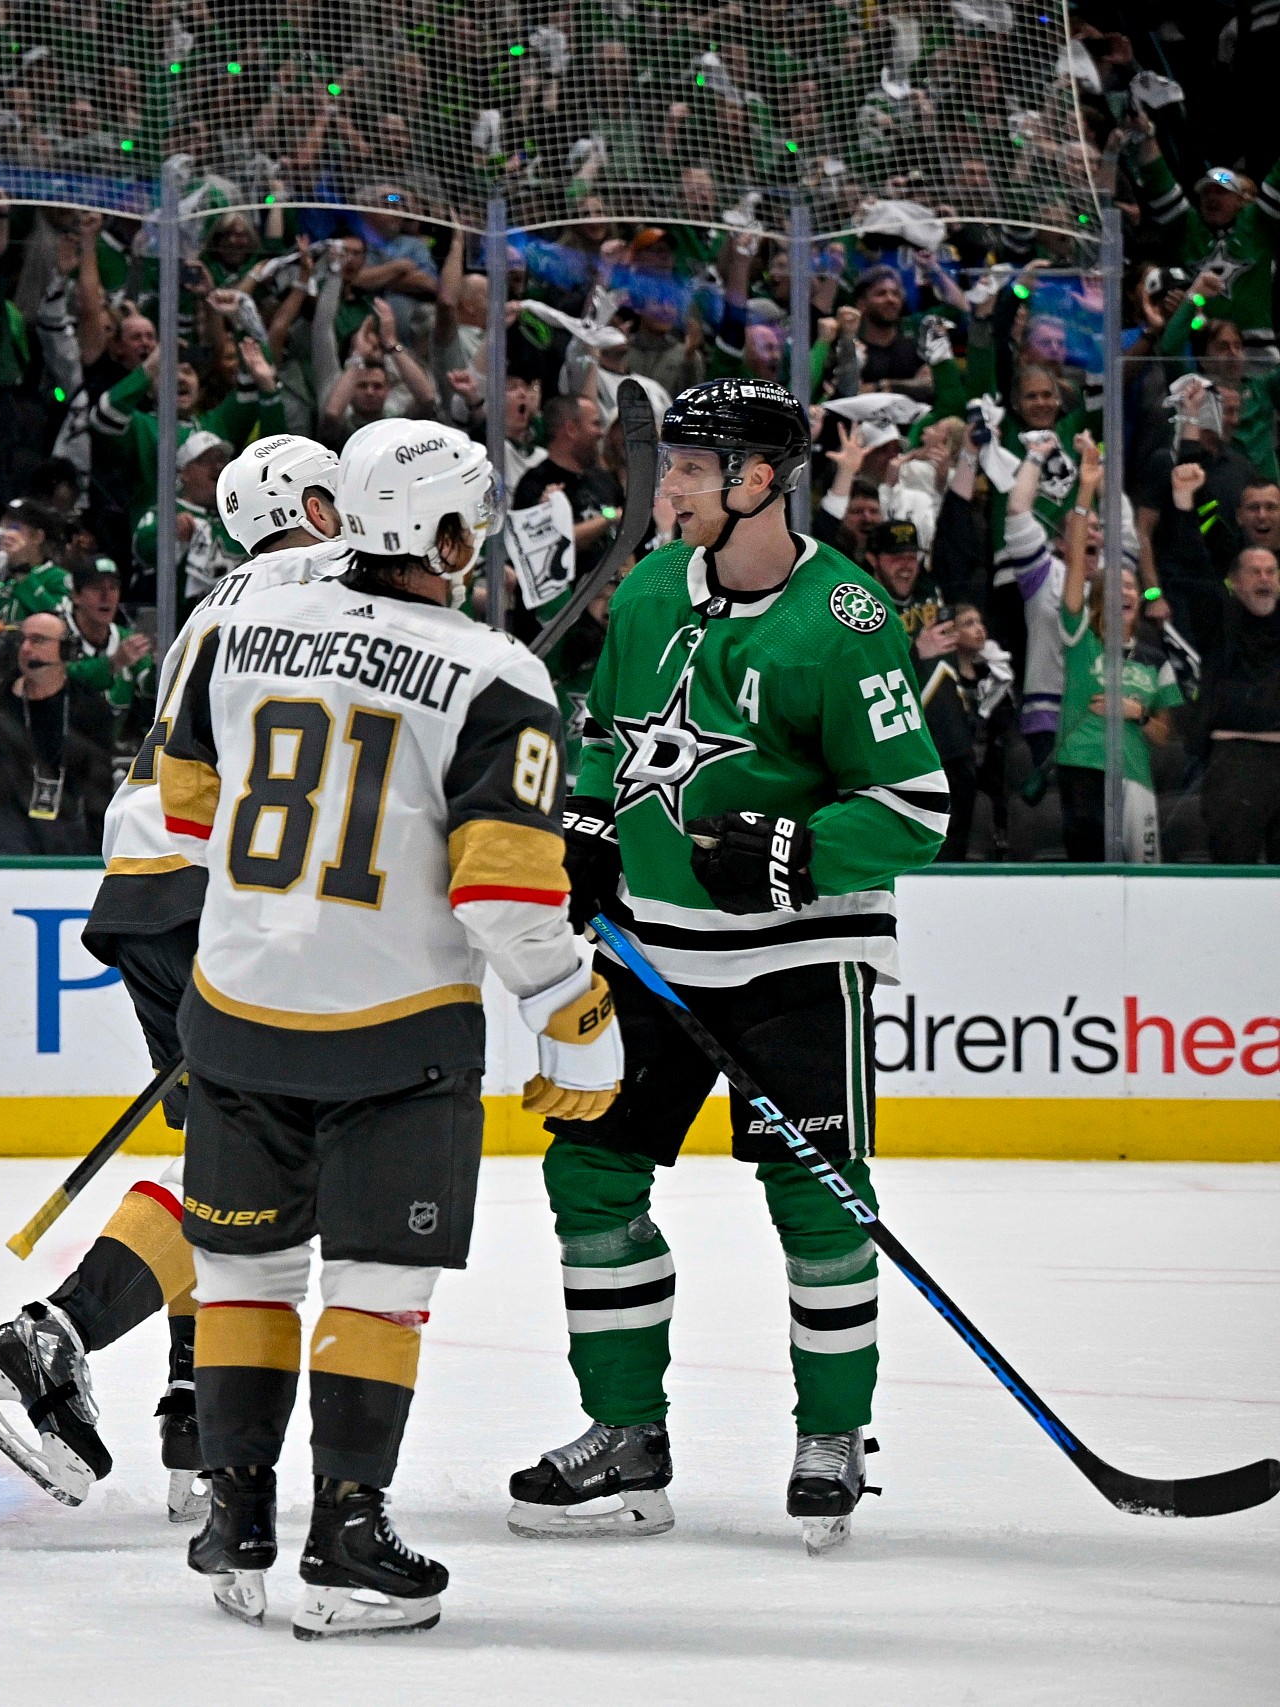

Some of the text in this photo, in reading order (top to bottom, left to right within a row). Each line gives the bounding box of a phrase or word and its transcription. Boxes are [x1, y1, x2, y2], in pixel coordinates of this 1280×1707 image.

[225, 490, 239, 515] 48
[346, 513, 365, 536] 81
[224, 625, 471, 713] MARCHESSAULT
[736, 667, 761, 724] A
[859, 668, 922, 743] 23
[226, 695, 402, 911] 81
[512, 726, 559, 815] 81
[769, 817, 797, 913] BAUER
[593, 917, 623, 949] BAUER
[12, 908, 124, 1053] P
[184, 1196, 279, 1226] BAUER
